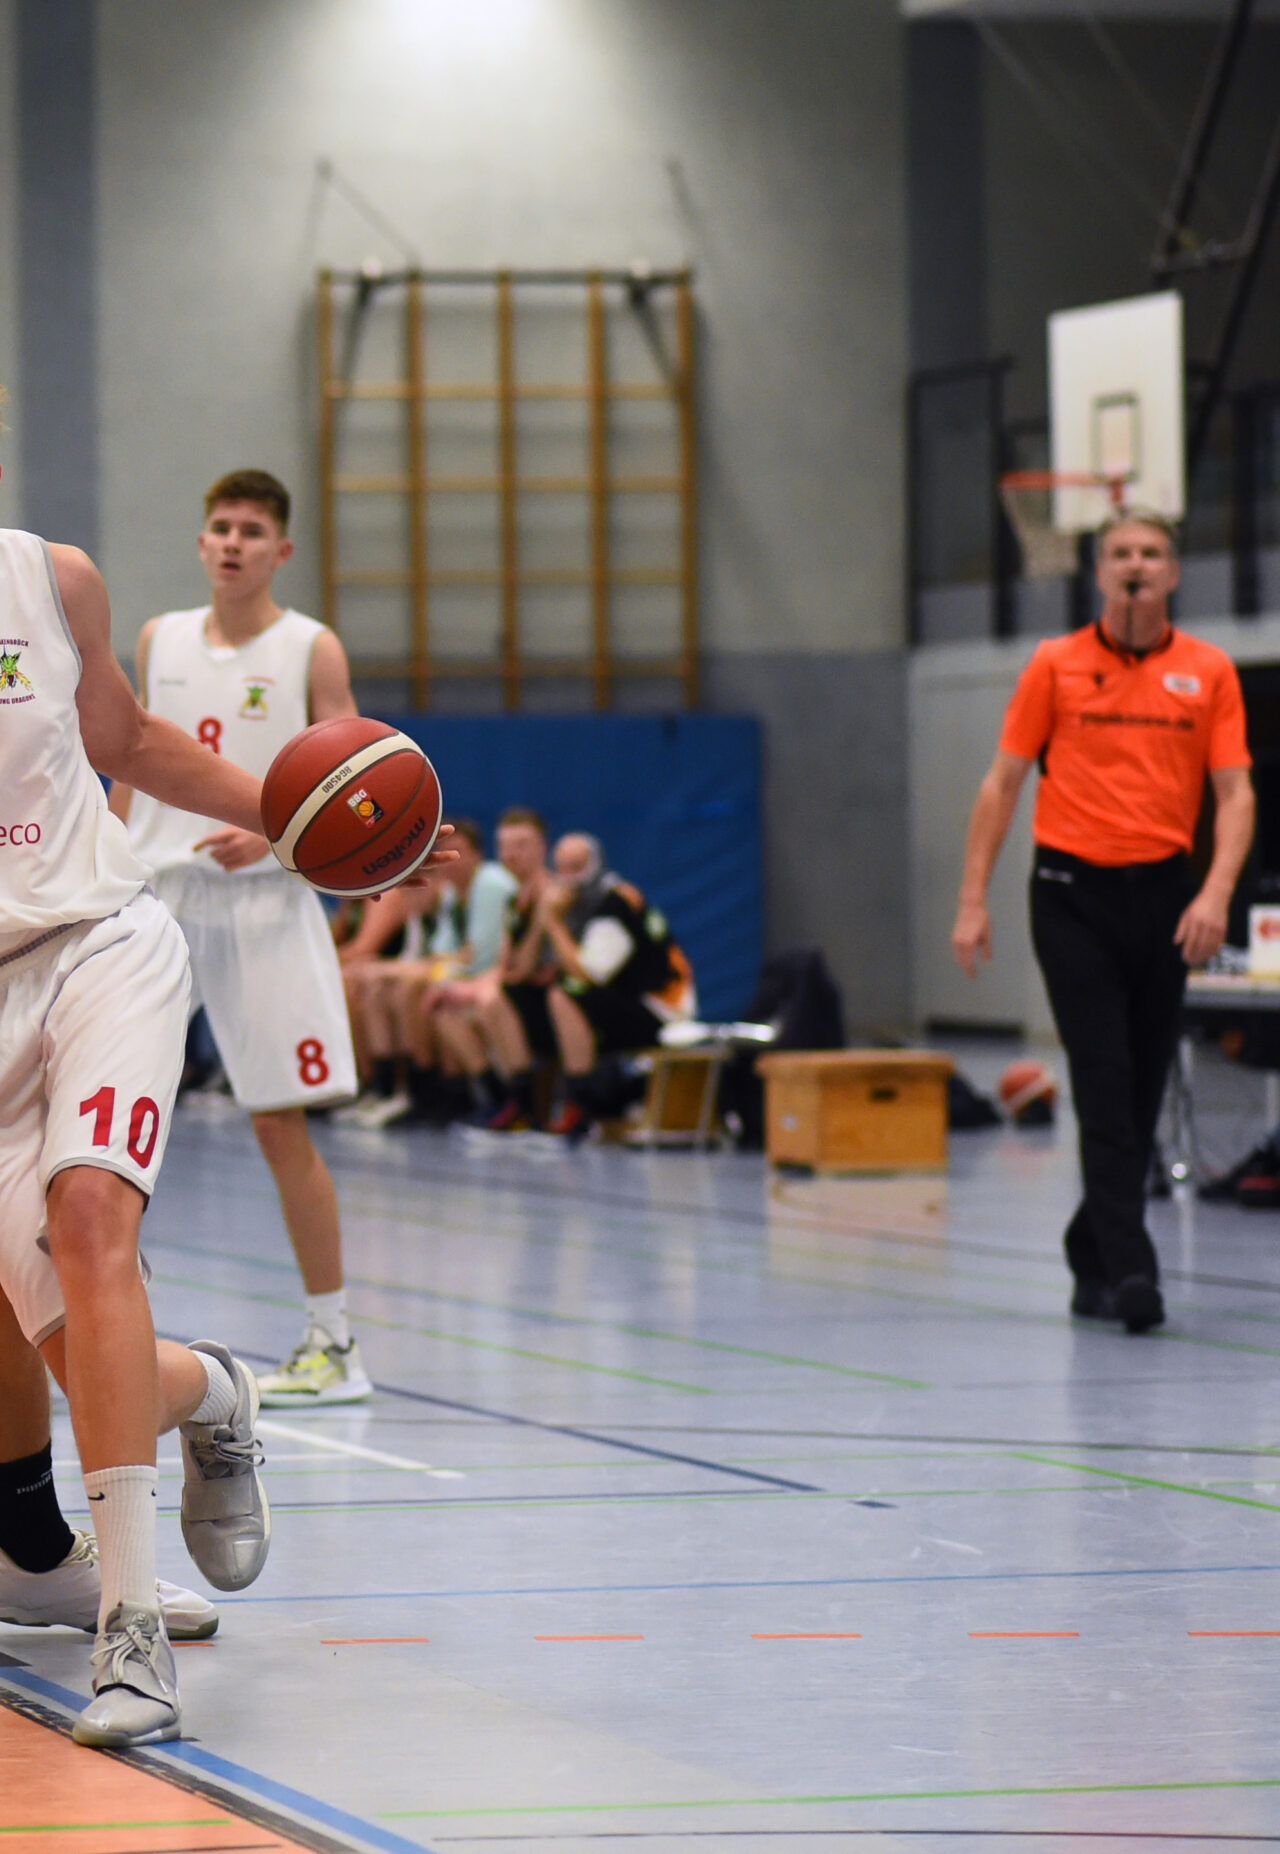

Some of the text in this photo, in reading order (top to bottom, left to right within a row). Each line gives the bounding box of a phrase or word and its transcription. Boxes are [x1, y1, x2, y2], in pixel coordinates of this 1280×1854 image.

[11, 693, 36, 705] DRAGONS
[321, 766, 353, 794] BG4500
[347, 788, 368, 808] DBB
[362, 816, 426, 875] molten
[296, 1037, 330, 1087] 8
[79, 1086, 160, 1169] 10
